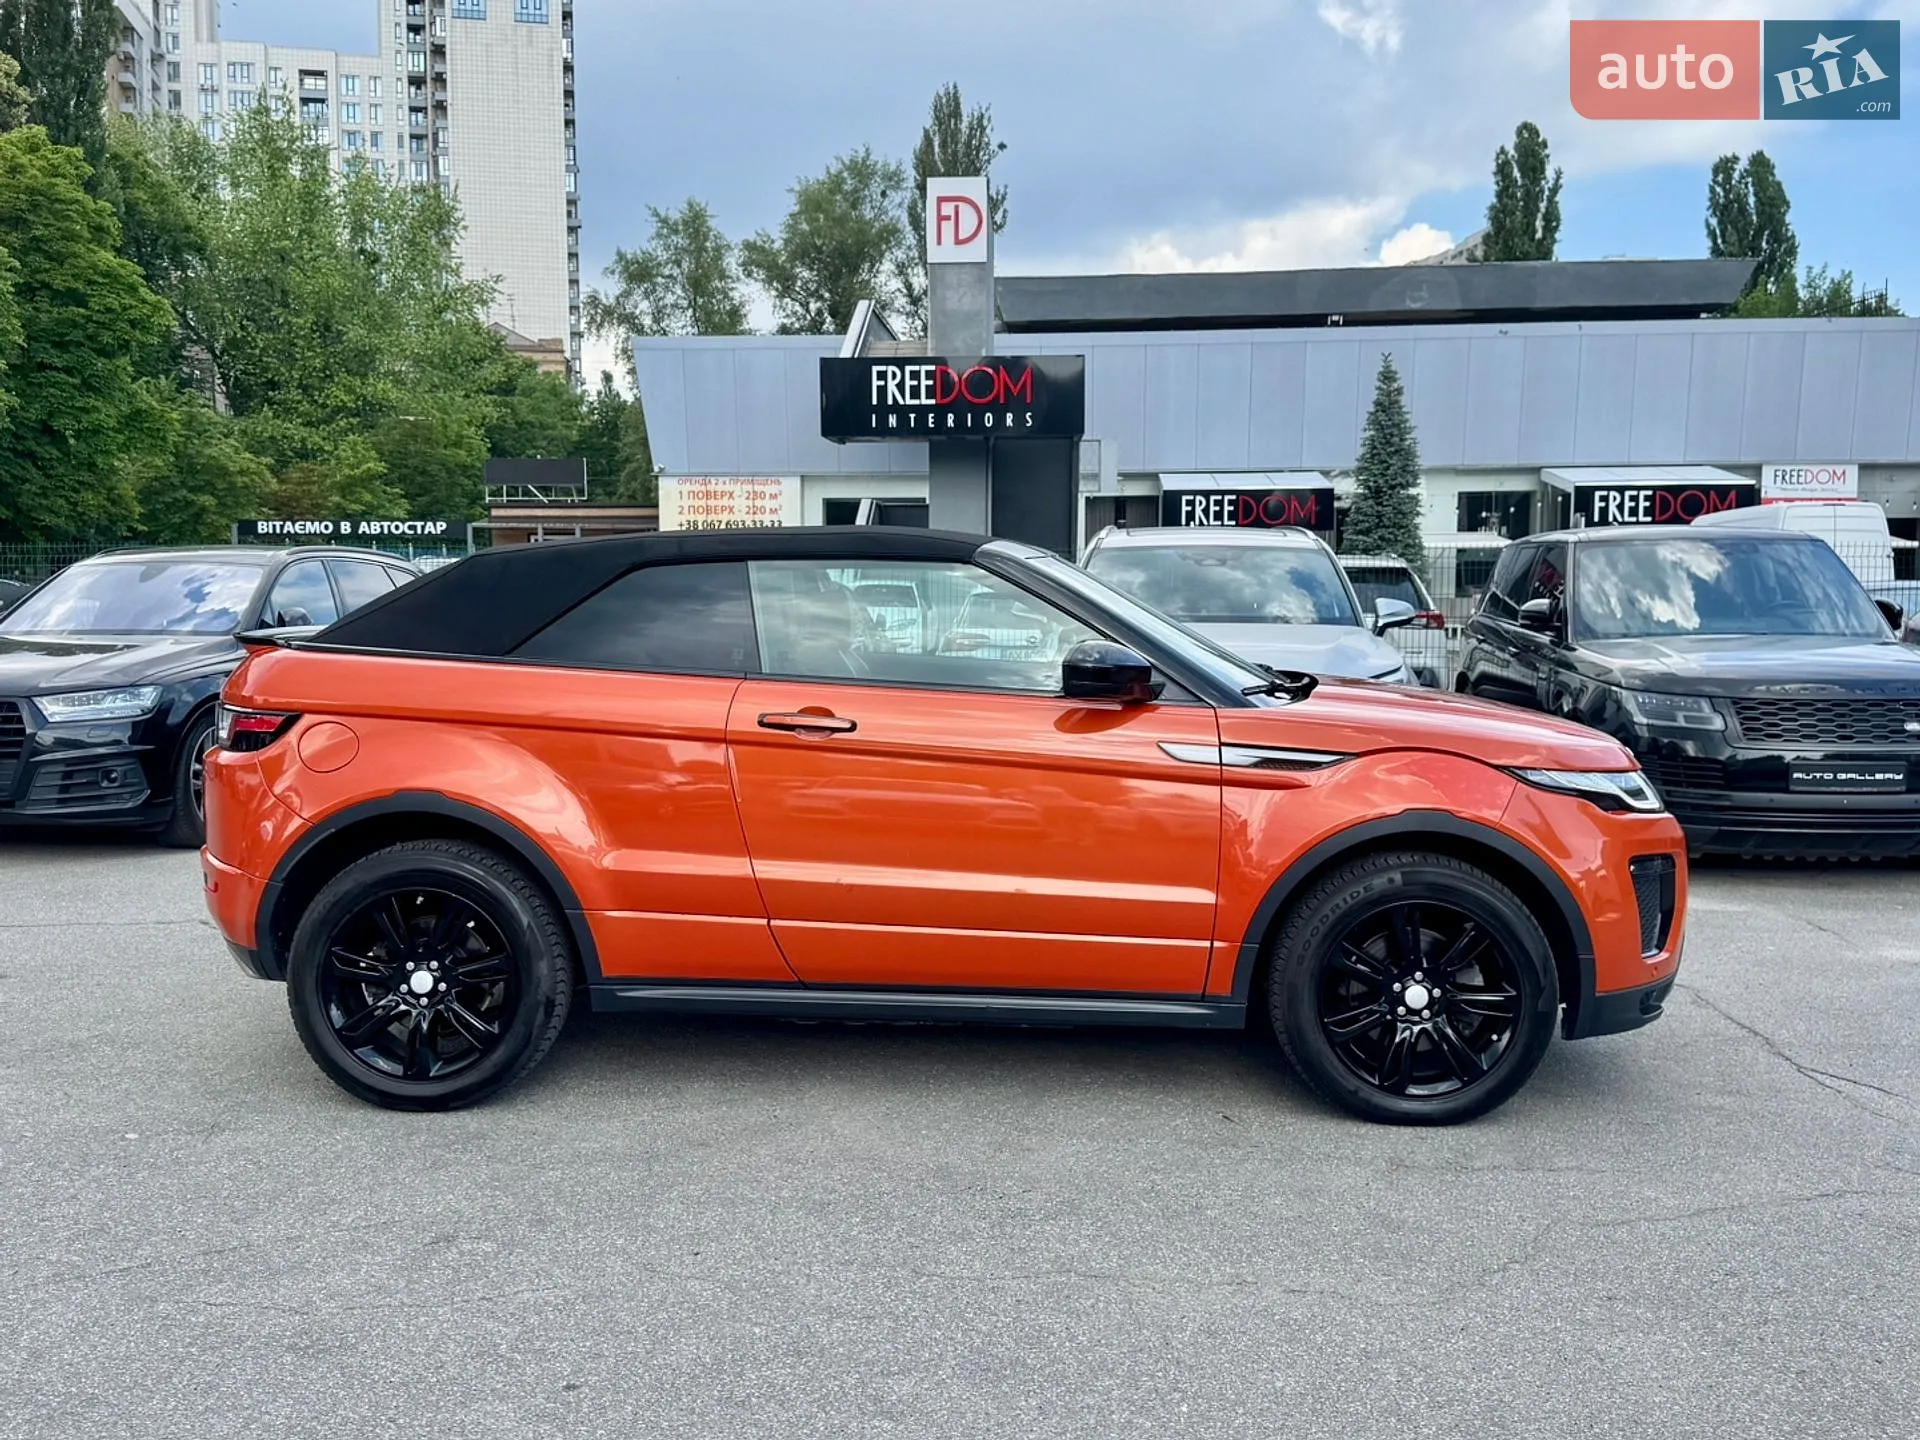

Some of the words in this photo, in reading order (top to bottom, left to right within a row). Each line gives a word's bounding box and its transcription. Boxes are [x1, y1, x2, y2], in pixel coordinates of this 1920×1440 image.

[936, 195, 983, 246] FD
[871, 364, 1033, 406] FREEDOM
[871, 412, 1033, 428] INTERIORS
[1772, 468, 1846, 486] FREEDOM
[688, 491, 735, 500] ПОВЕРХ
[745, 491, 766, 500] 230
[678, 506, 684, 515] 2
[688, 506, 735, 515] ПОВЕРХ
[745, 506, 766, 515] 220
[1181, 495, 1316, 526] FREEDOM
[1594, 490, 1737, 522] FREEDOM
[257, 521, 333, 534] ВІТАЄМО
[340, 521, 351, 534] В
[358, 521, 447, 535] АВТОСТАР
[678, 520, 699, 530] +38
[701, 520, 722, 529] 067
